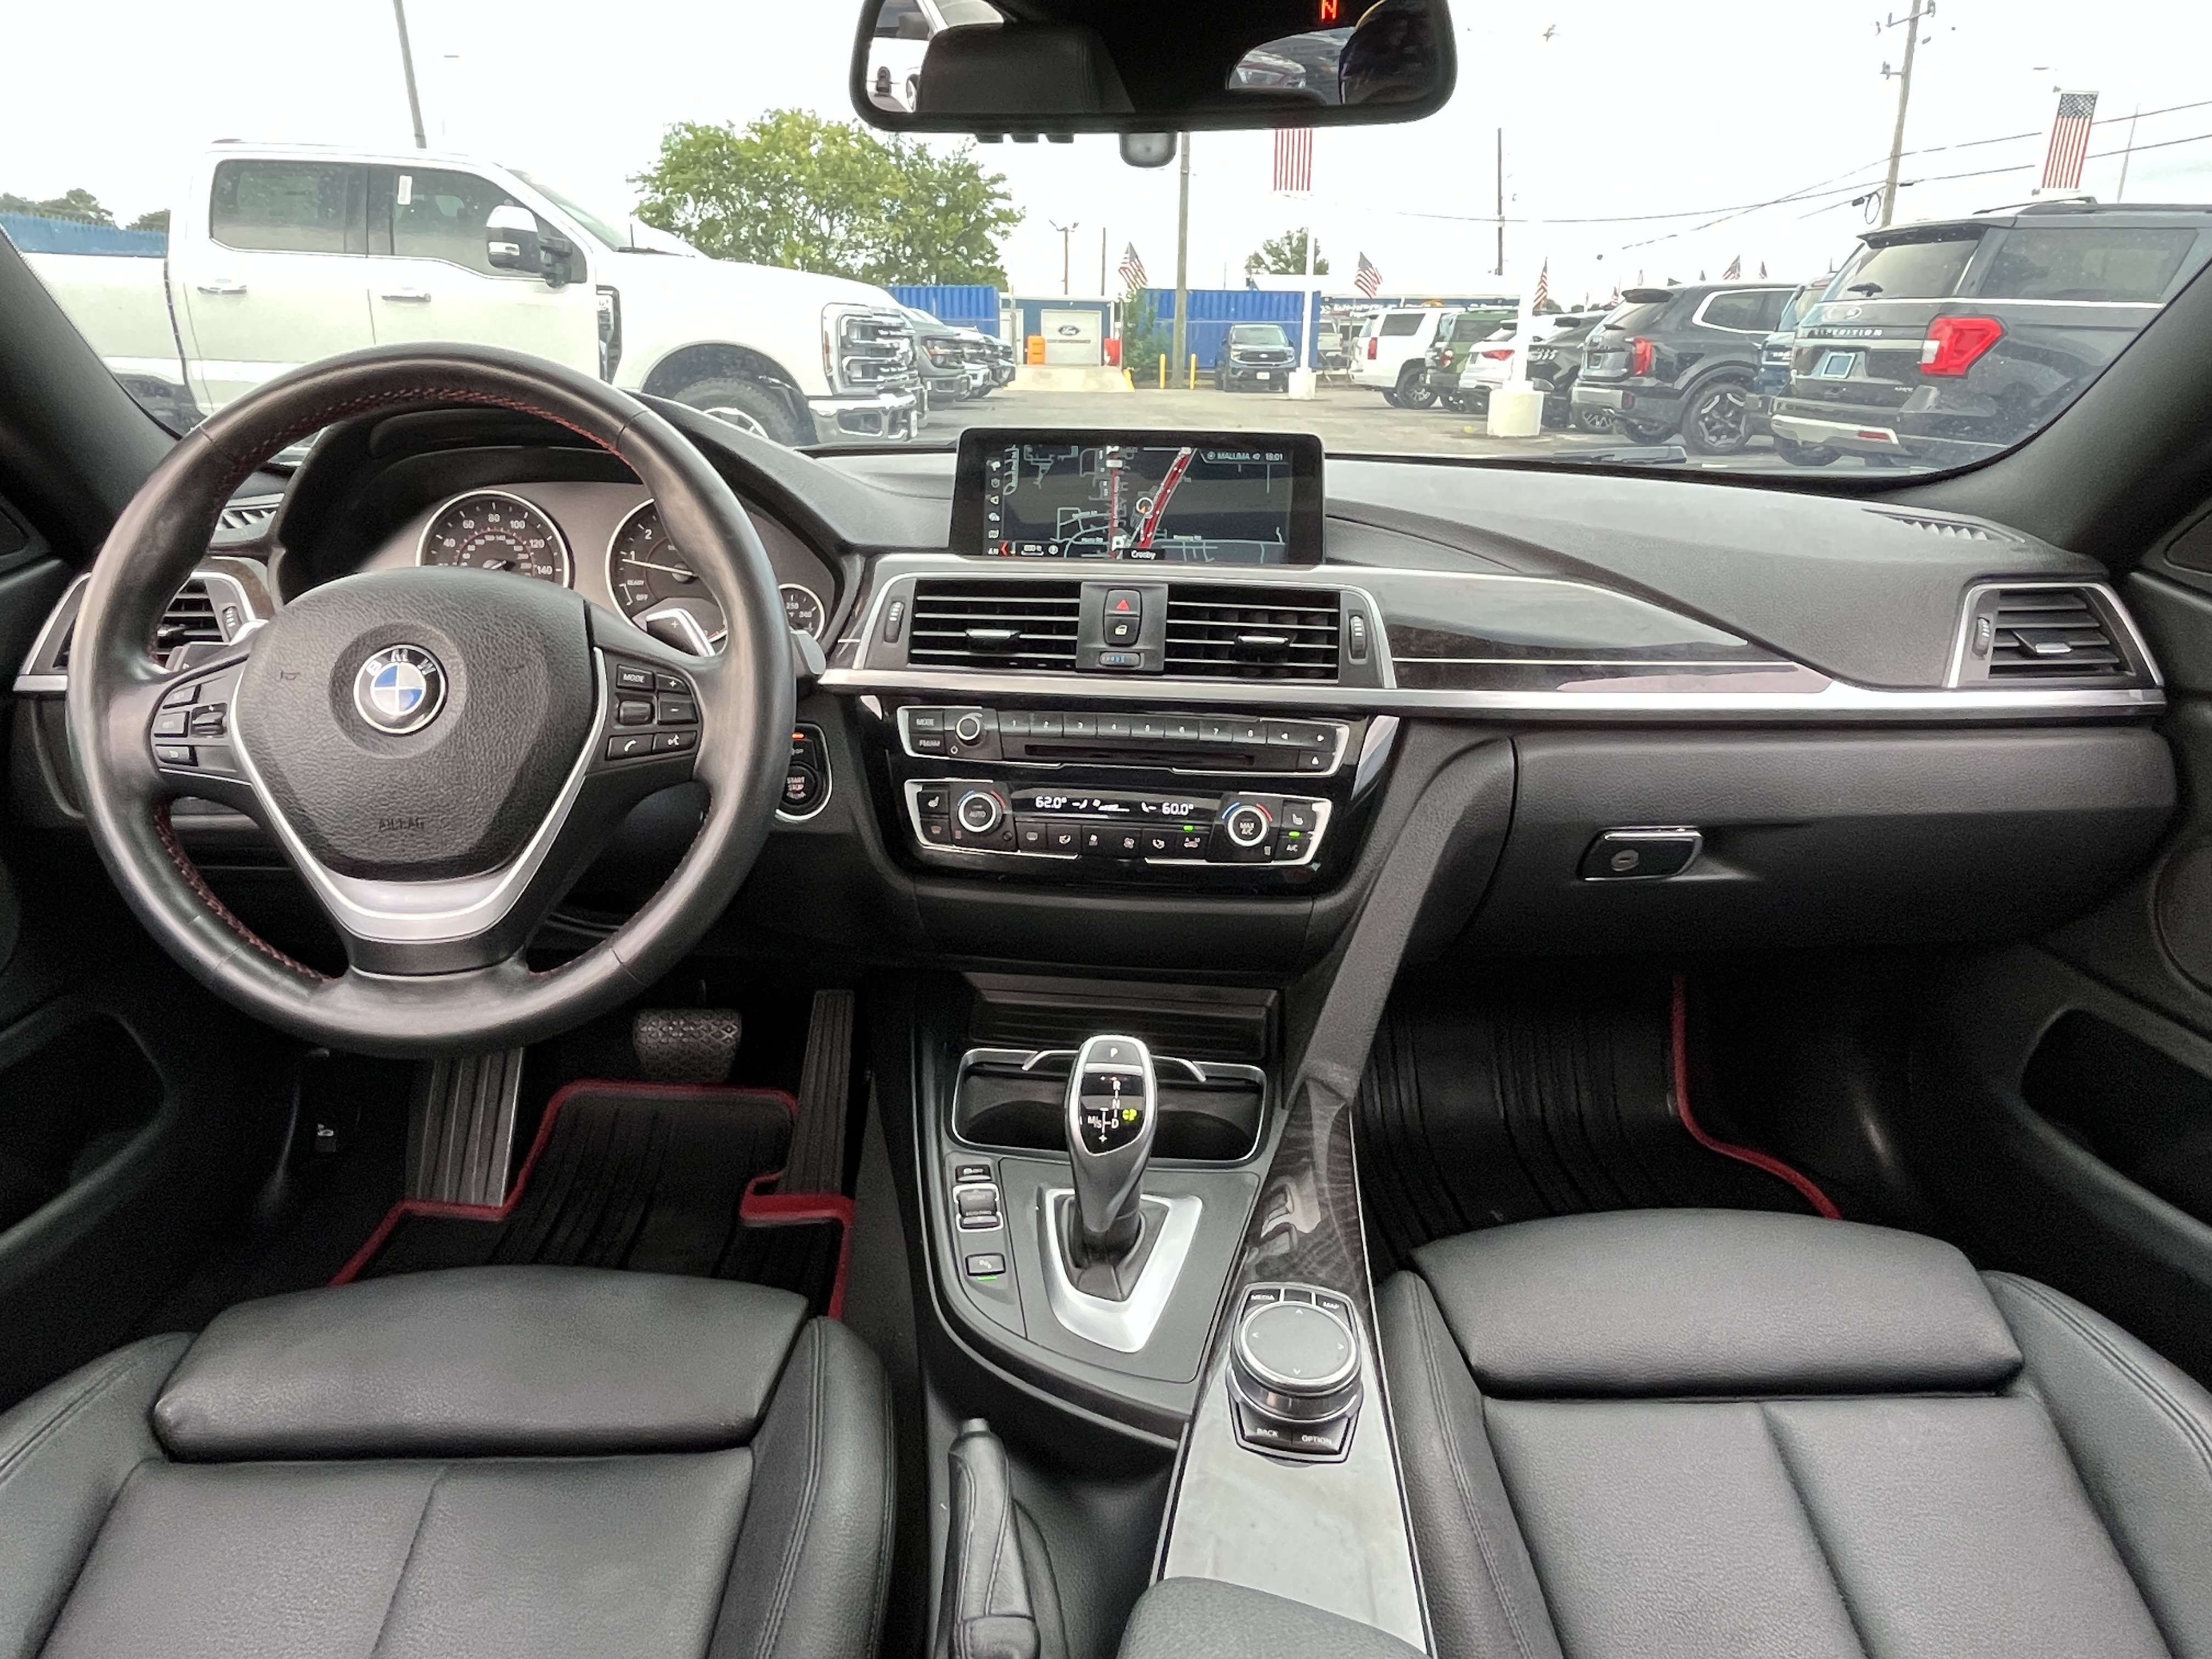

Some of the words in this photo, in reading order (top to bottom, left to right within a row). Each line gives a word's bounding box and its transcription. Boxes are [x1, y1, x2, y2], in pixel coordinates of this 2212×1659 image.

[1321, 0, 1336, 19] N
[488, 514, 500, 522] 80
[462, 520, 475, 529] 60
[510, 520, 525, 529] 100
[645, 529, 653, 540] 2
[443, 538, 456, 548] 40
[529, 539, 545, 549] 120
[630, 550, 635, 561] 1
[537, 565, 553, 575] 140
[366, 648, 437, 676] BMW
[623, 673, 645, 684] MODE
[1110, 1047, 1118, 1058] P
[1113, 1080, 1121, 1091] R
[1111, 1098, 1120, 1109] N
[1111, 1118, 1119, 1129] D
[1323, 1301, 1340, 1310] MAP
[1256, 1427, 1278, 1437] BACK
[1301, 1434, 1332, 1445] OPTION
